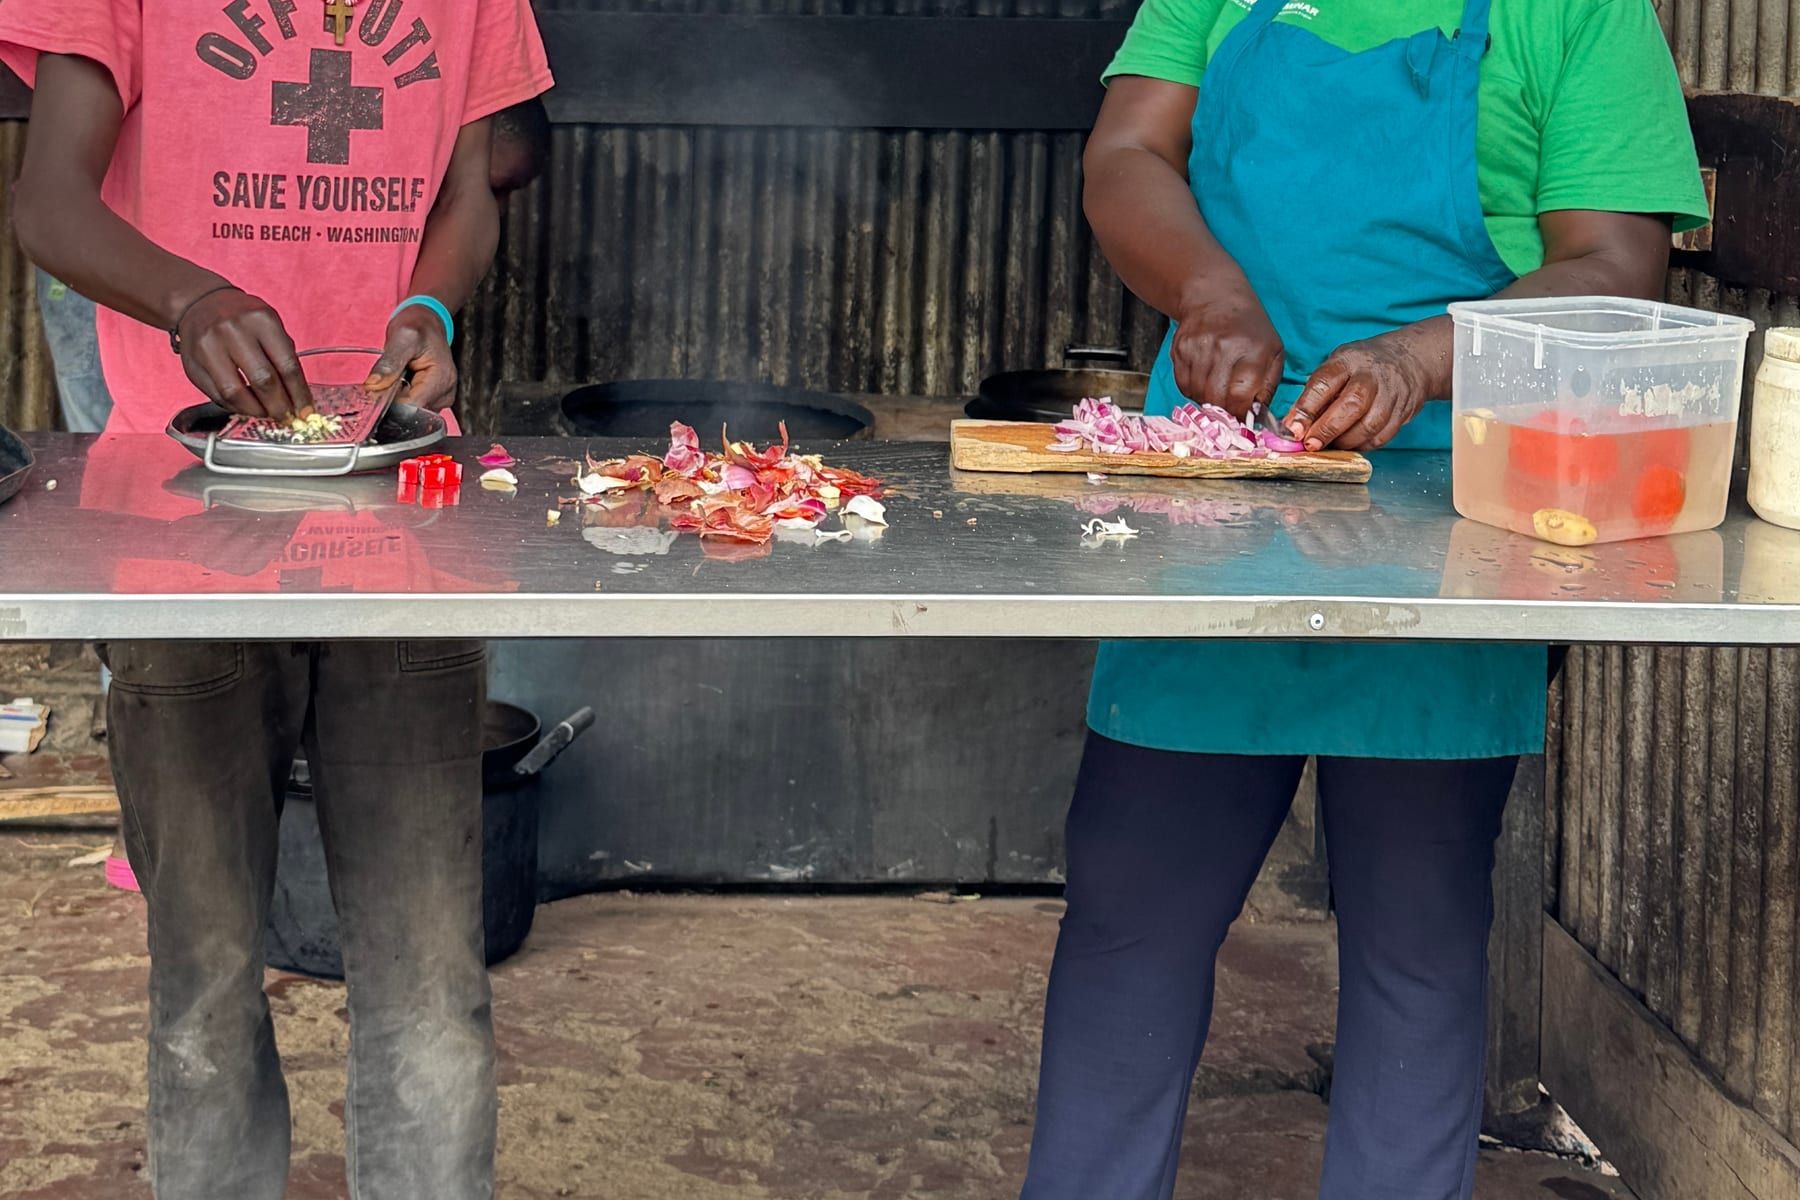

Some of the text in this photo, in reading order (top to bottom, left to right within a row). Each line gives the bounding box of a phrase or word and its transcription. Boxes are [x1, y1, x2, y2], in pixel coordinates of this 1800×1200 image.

[1282, 2, 1319, 16] MINAR
[212, 171, 425, 213] SAVE YOURSELF
[212, 223, 420, 244] LONG BEACH WASHINGTON
